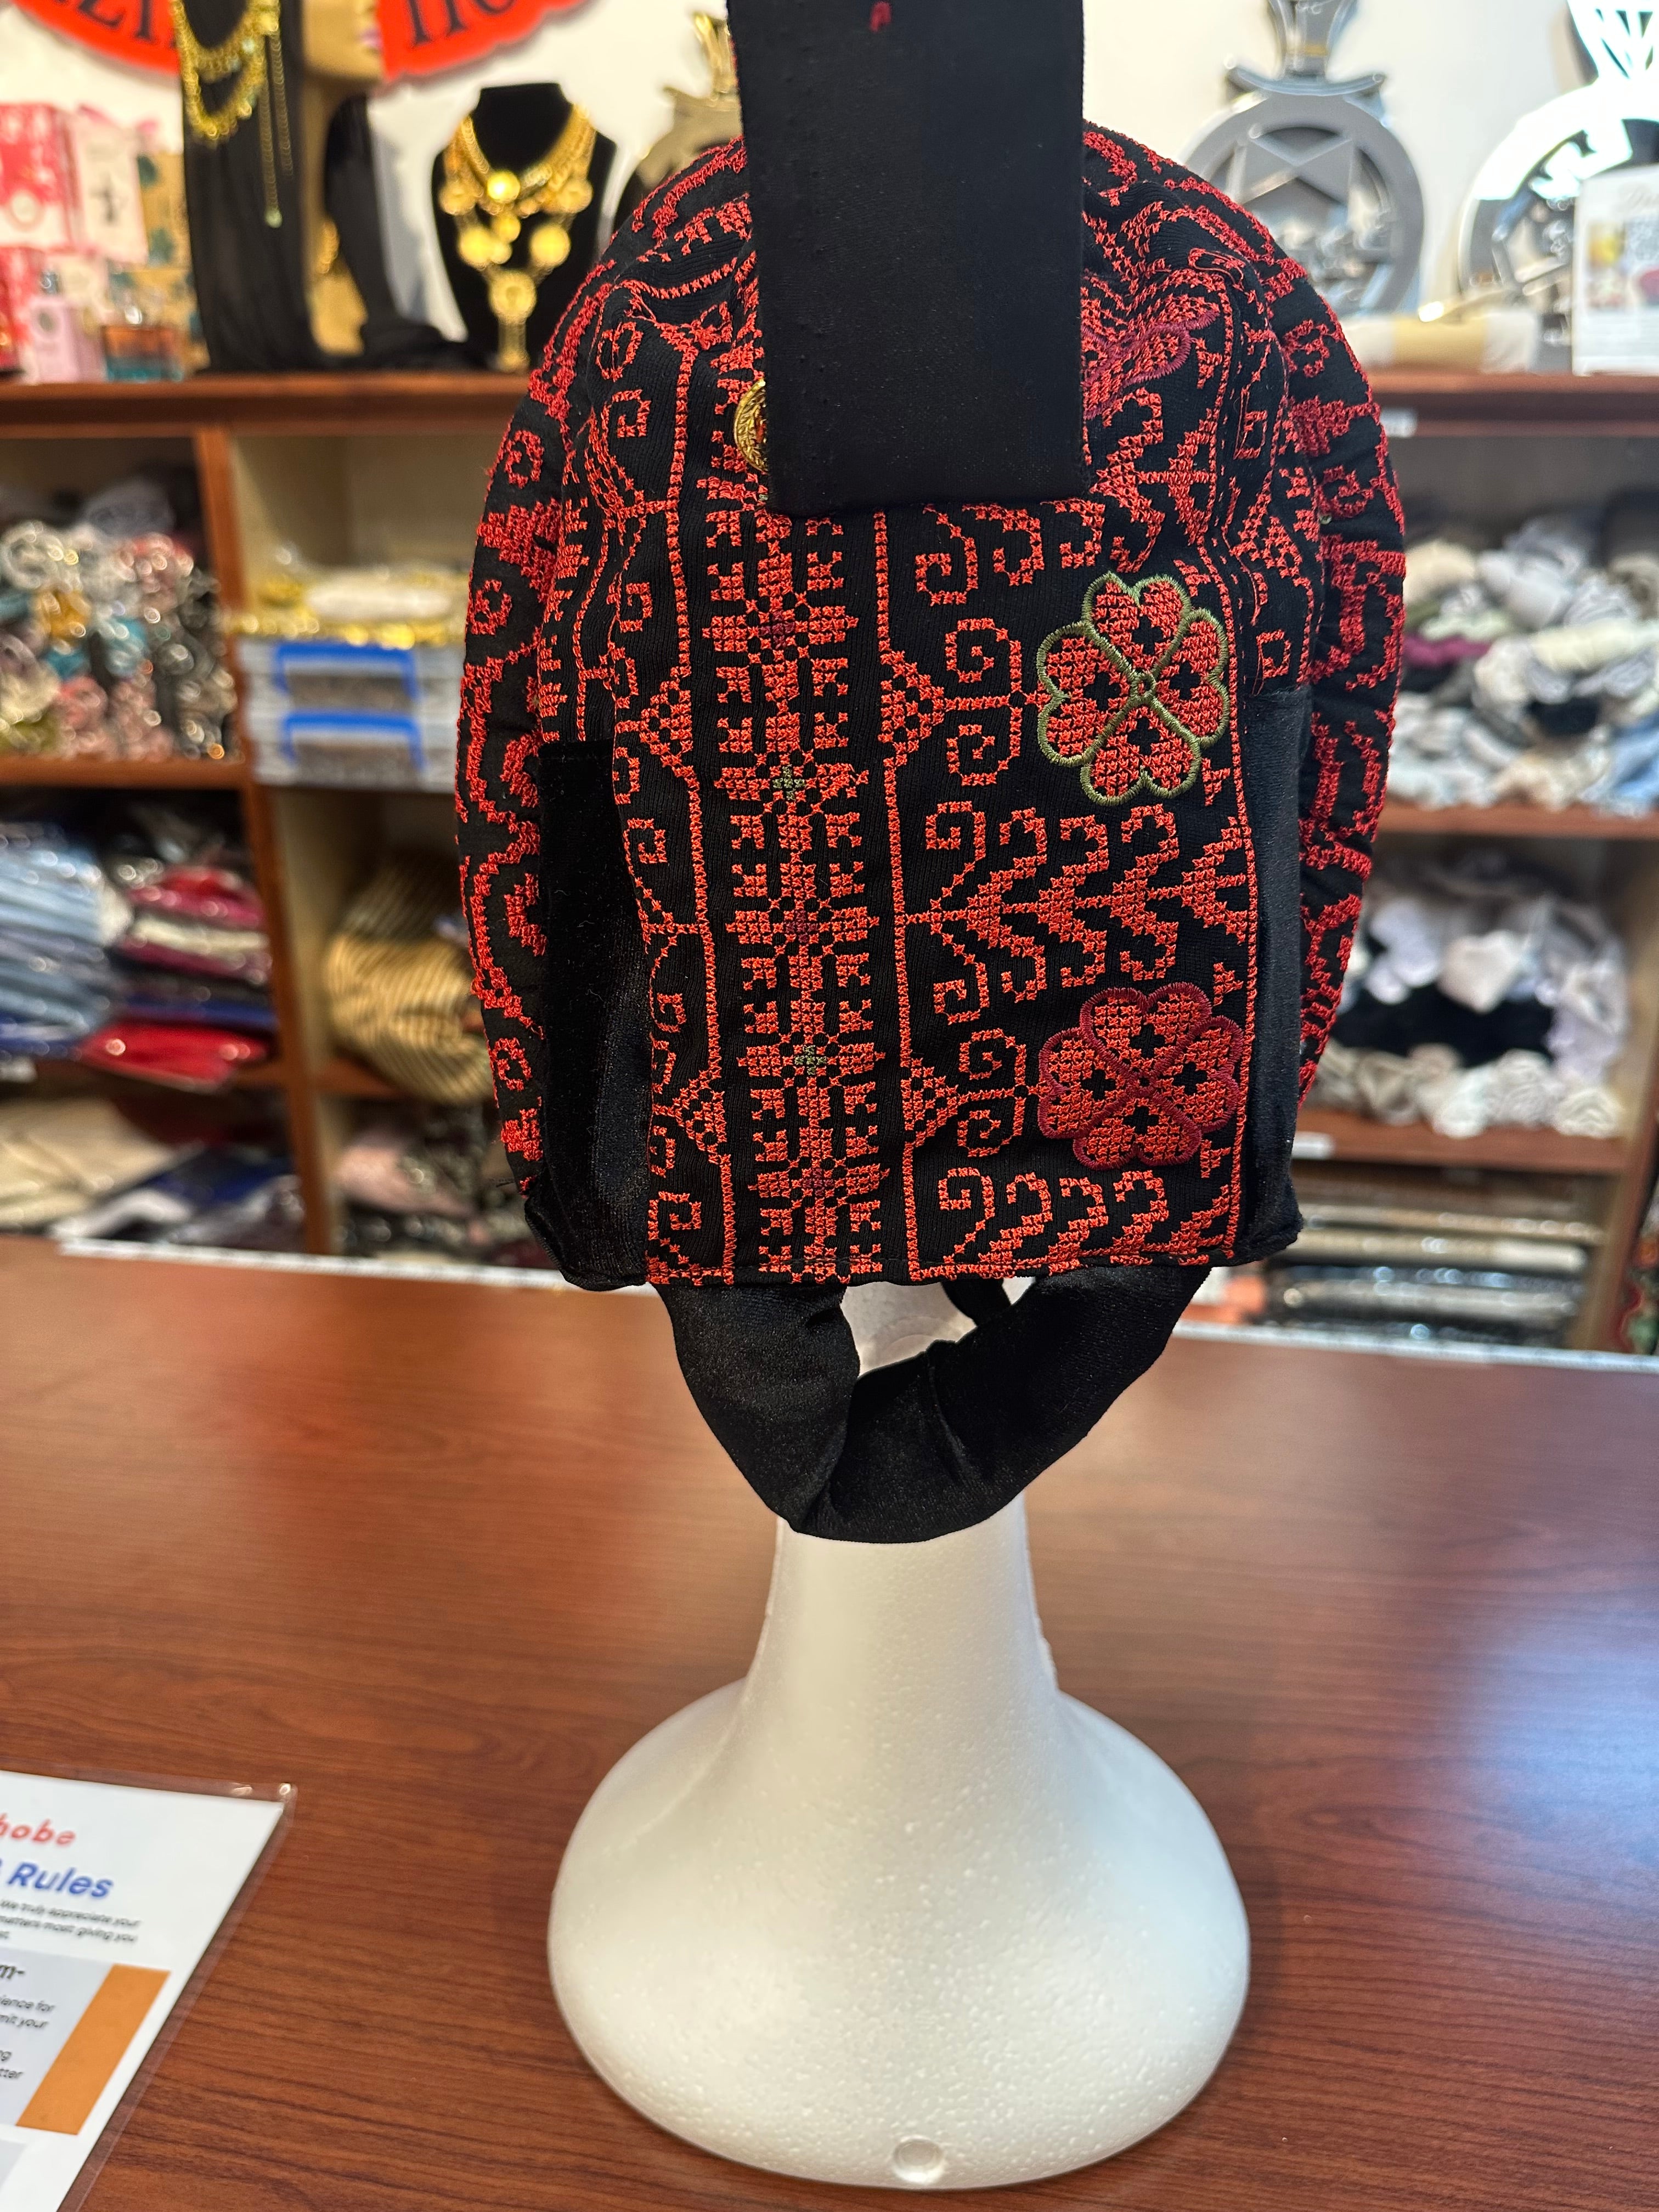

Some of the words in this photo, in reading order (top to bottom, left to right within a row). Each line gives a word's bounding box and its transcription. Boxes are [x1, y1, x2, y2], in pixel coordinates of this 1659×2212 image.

[8, 1861, 114, 1898] Rules
[48, 1908, 112, 1923] appreciate
[112, 1917, 140, 1927] your
[43, 1922, 75, 1933] most
[77, 1927, 114, 1940] giving
[36, 2000, 56, 2012] for
[17, 2018, 49, 2029] your
